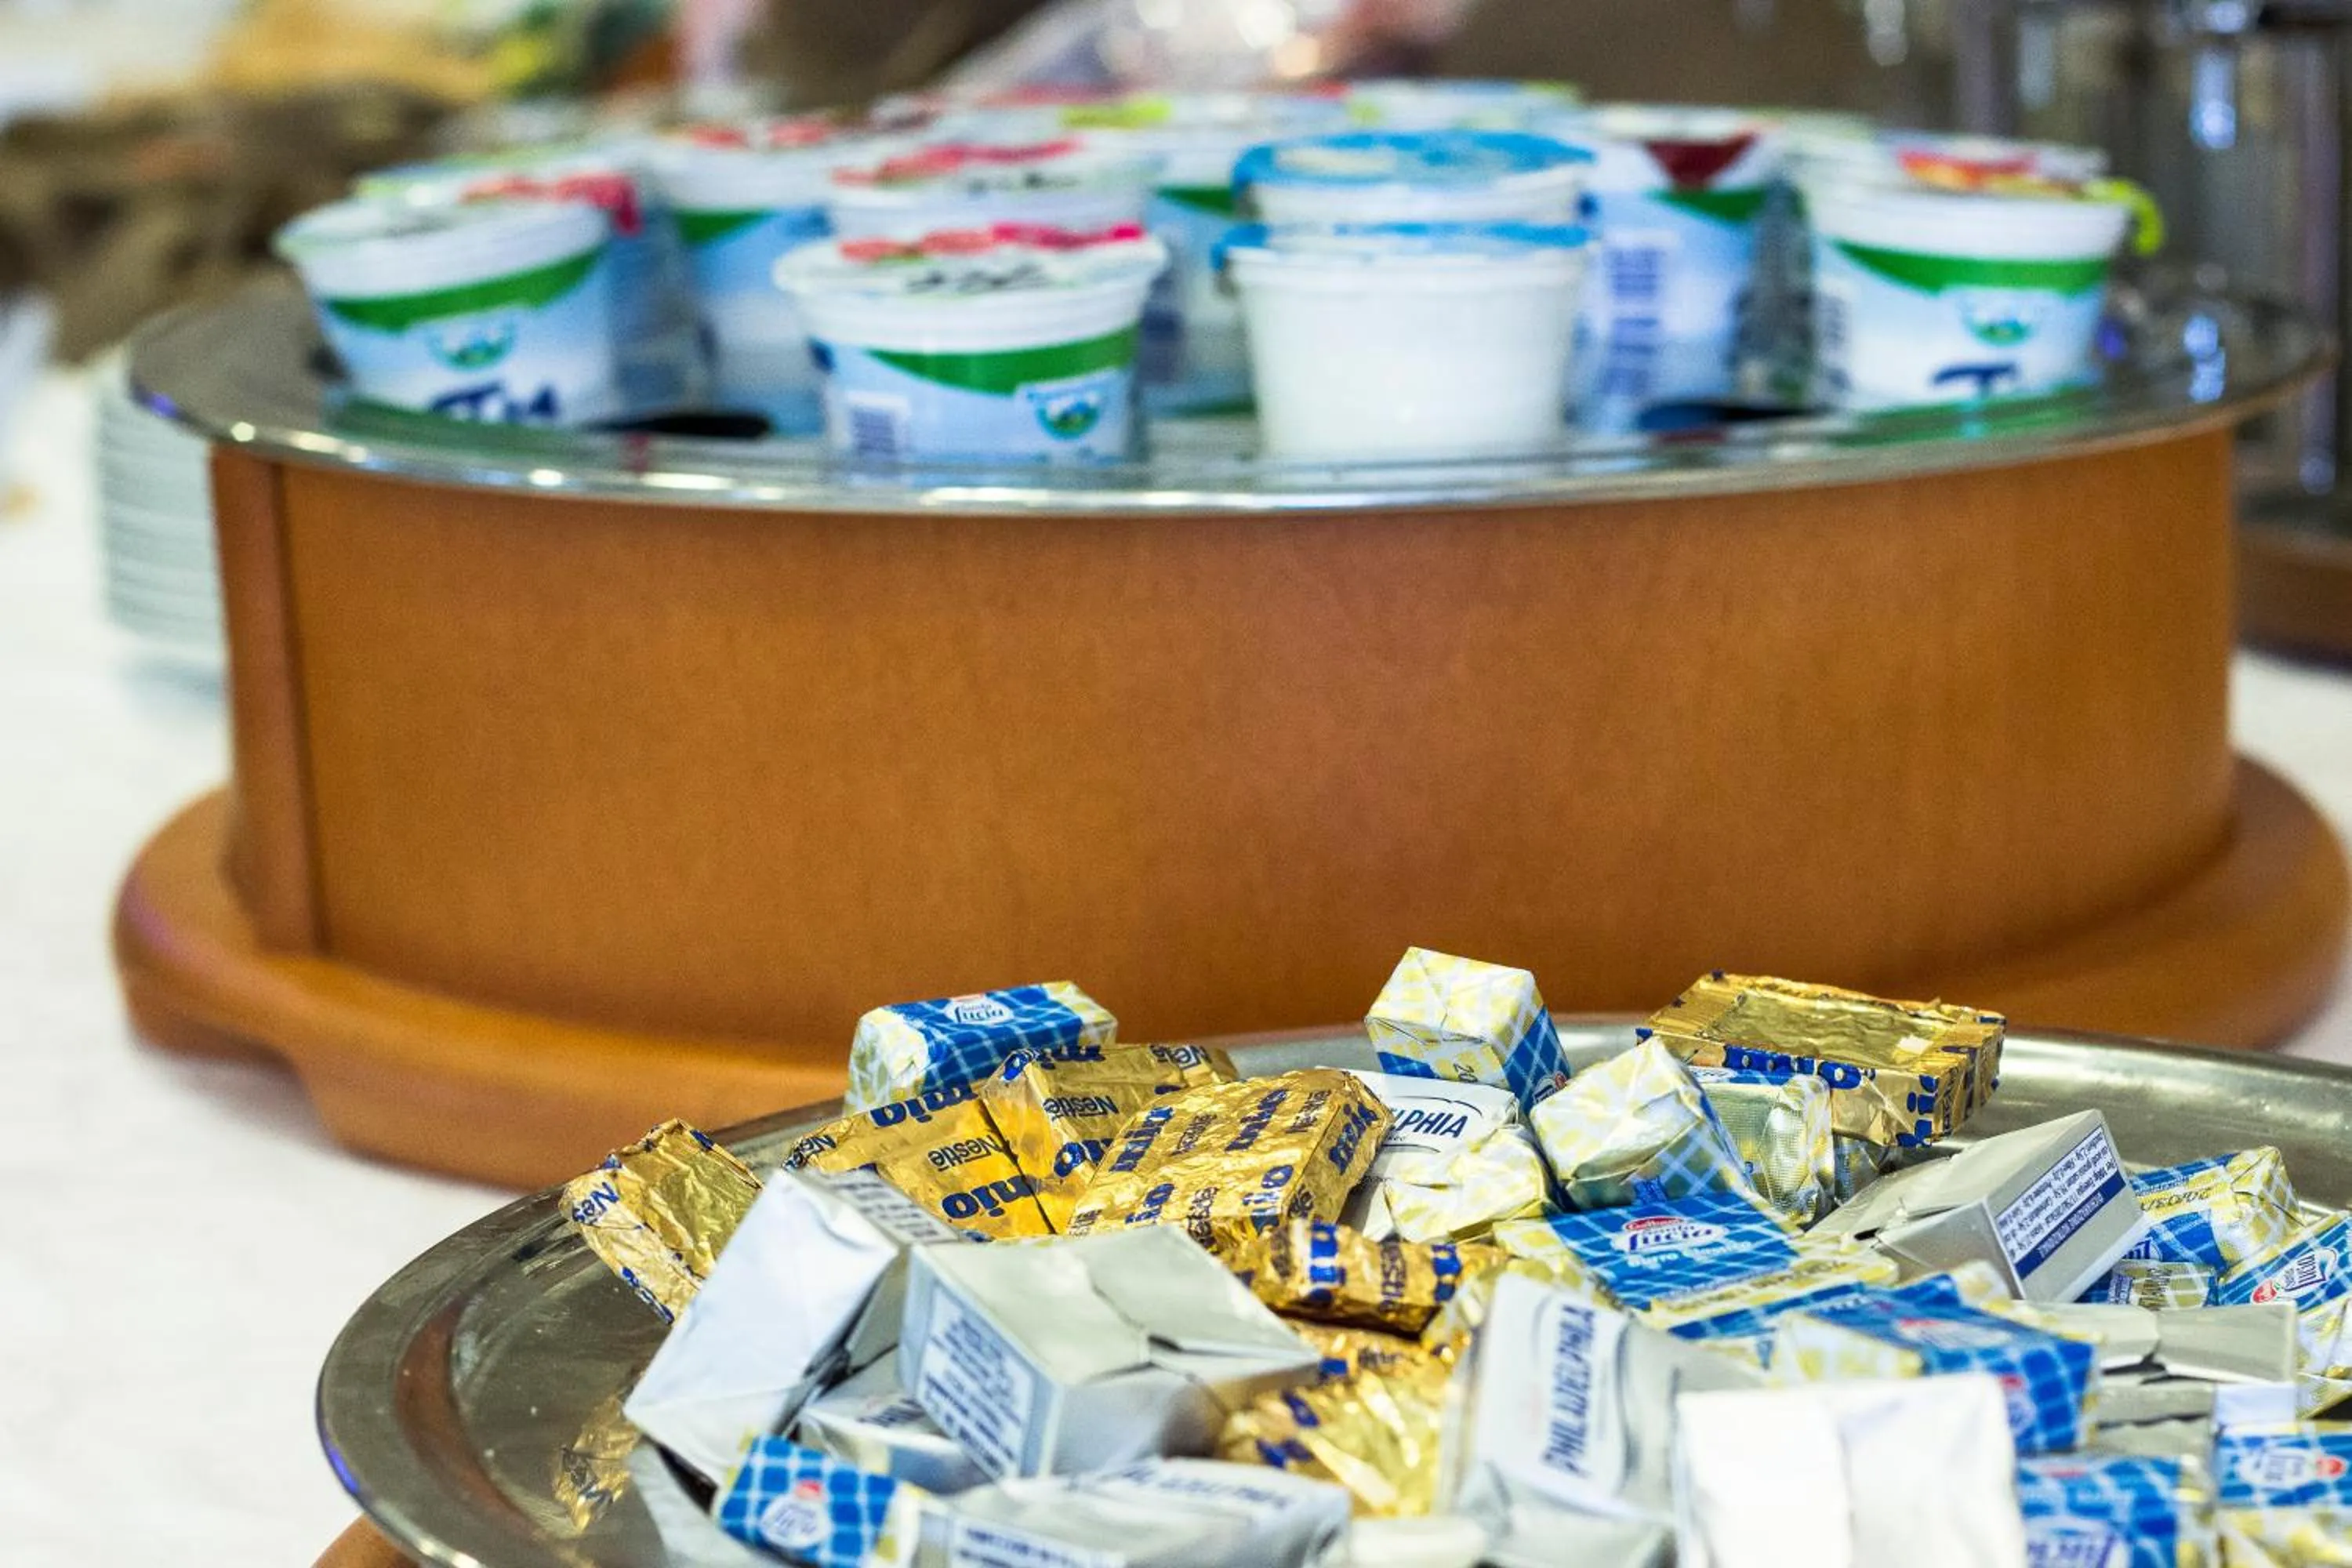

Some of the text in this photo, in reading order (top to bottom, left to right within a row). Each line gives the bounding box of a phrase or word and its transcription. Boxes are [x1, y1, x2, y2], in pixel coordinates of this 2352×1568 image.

[870, 1084, 979, 1128] mio
[1391, 1108, 1468, 1138] LPHIA
[1124, 1182, 1175, 1225] io
